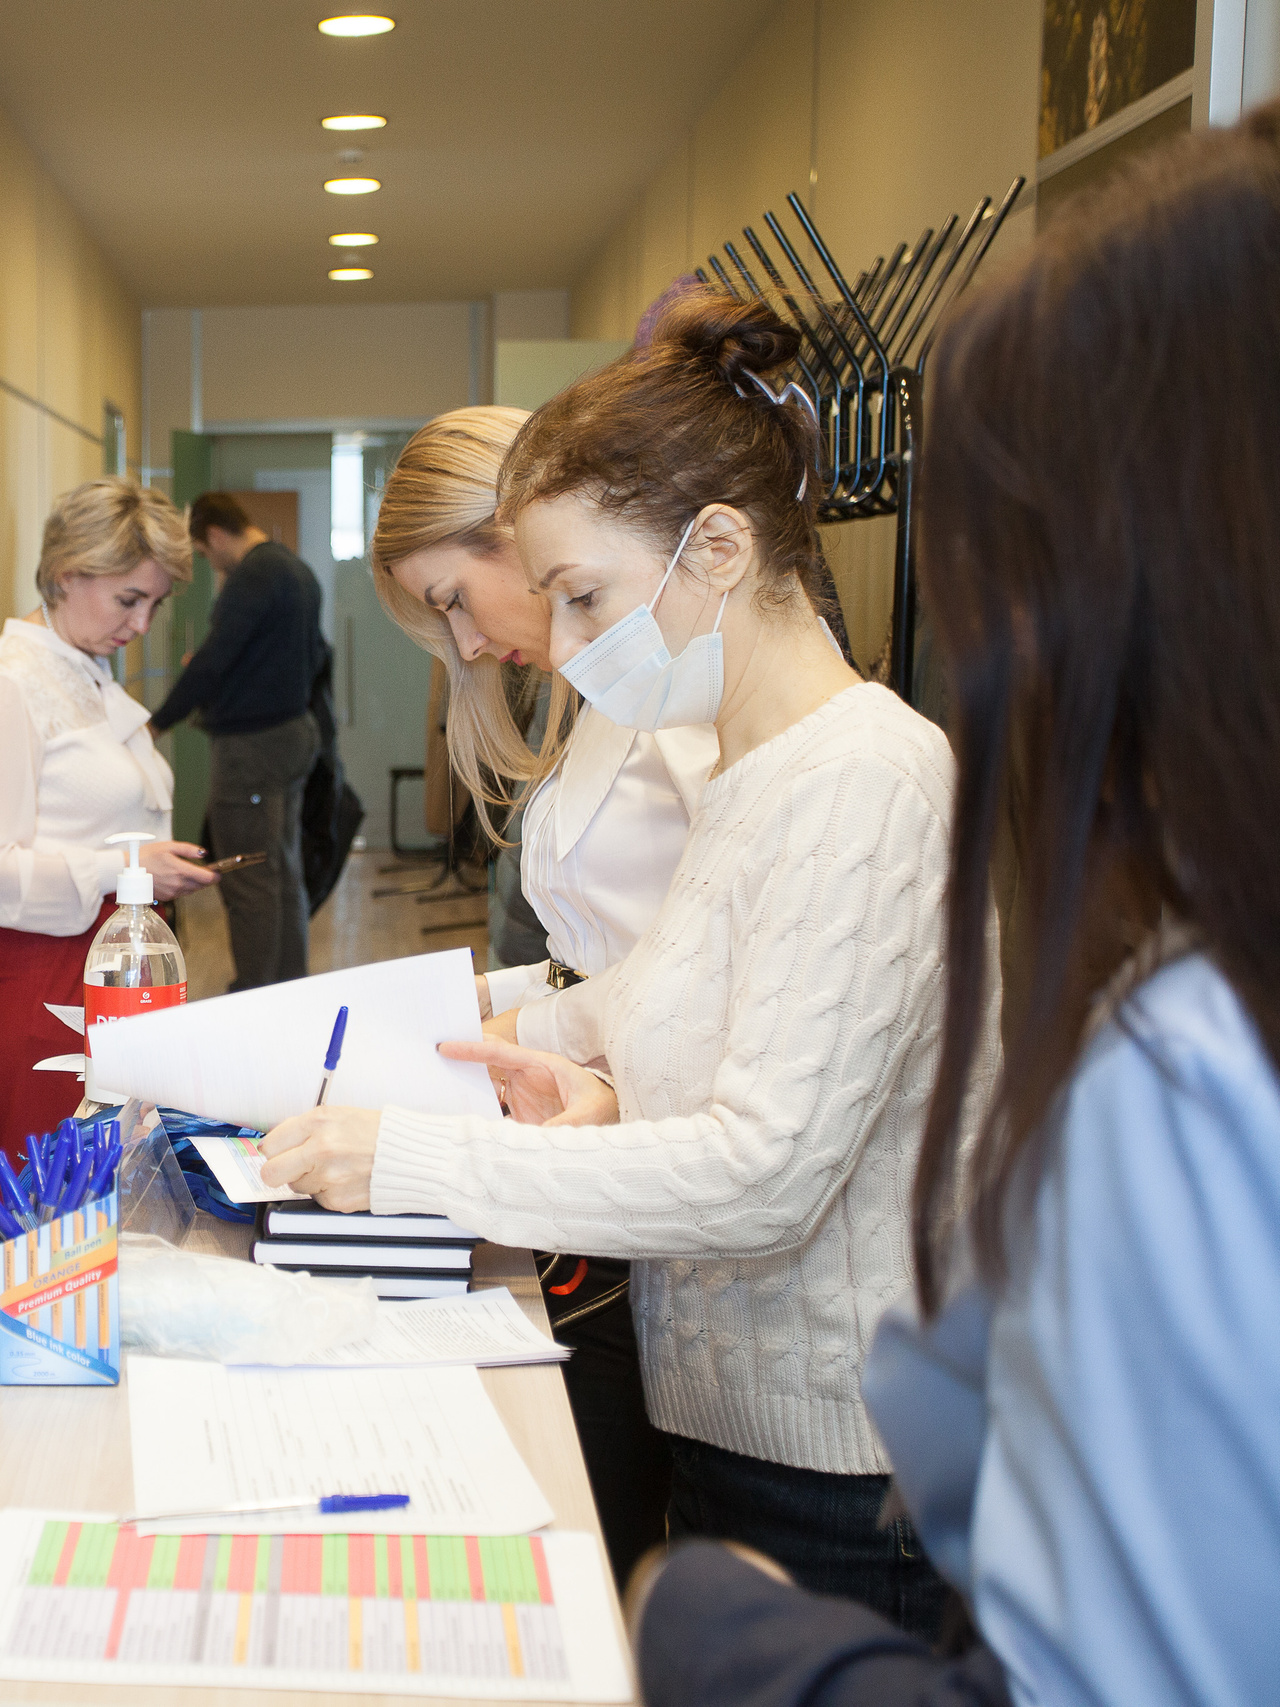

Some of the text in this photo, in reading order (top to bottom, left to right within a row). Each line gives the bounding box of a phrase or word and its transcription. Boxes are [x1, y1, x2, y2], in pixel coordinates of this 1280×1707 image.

[64, 1238, 102, 1260] Ball pen
[17, 1288, 62, 1313] Premium
[65, 1269, 102, 1292] Quality
[33, 1262, 81, 1289] ORANGE
[25, 1329, 91, 1368] Blue ink color
